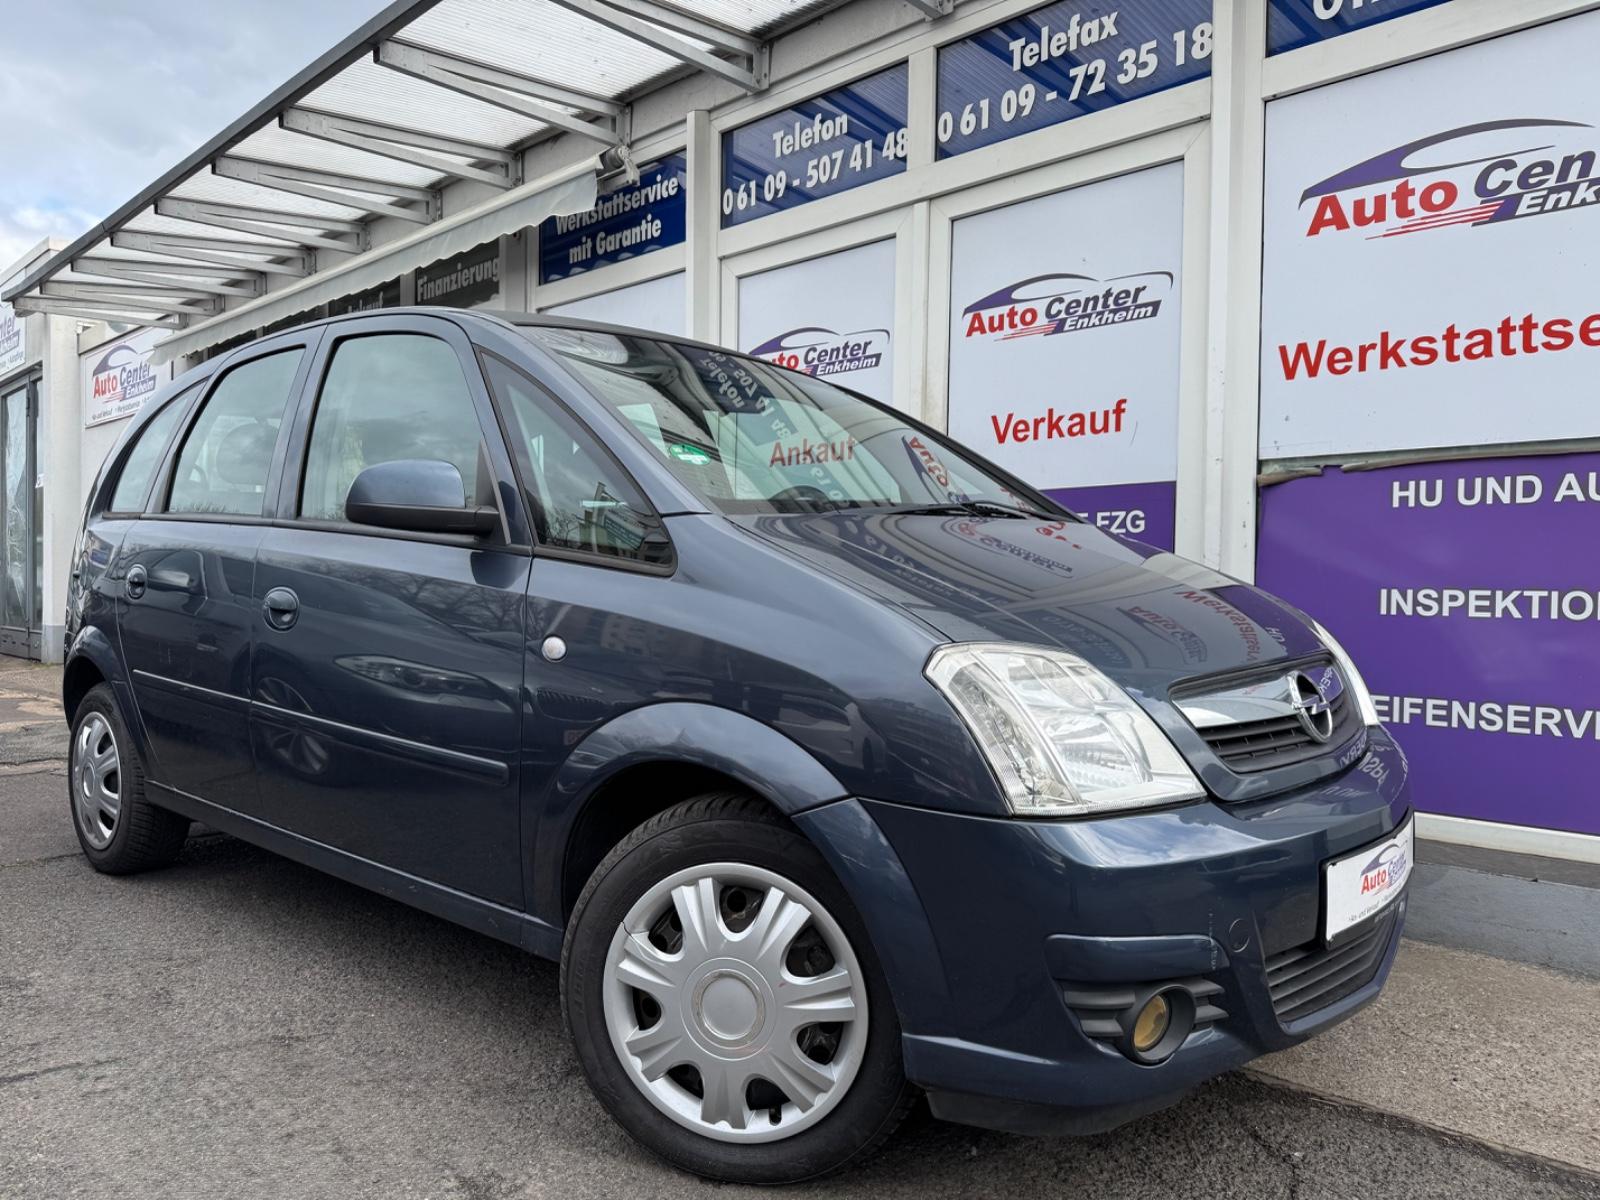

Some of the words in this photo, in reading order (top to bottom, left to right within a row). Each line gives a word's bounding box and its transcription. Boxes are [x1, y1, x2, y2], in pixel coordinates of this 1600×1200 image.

[1009, 11, 1118, 71] Telefax
[938, 112, 952, 143] 0
[960, 98, 989, 136] 61
[1000, 83, 1035, 122] 09
[1068, 59, 1106, 102] 72
[1117, 40, 1157, 85] 35
[1173, 22, 1213, 66] 18
[772, 113, 848, 158] Telefon
[723, 188, 733, 215] 0
[737, 180, 756, 210] 61
[764, 170, 787, 202] 09
[805, 149, 844, 188] 507
[849, 140, 873, 172] 41
[882, 127, 909, 160] 48
[1306, 178, 1458, 237] Auto
[569, 236, 593, 264] mit
[596, 214, 662, 255] Garantie
[417, 257, 500, 302] Finanzierung
[966, 305, 1038, 337] Auto
[1045, 285, 1147, 319] Center
[1063, 305, 1153, 332] Enkheim
[803, 340, 872, 365] Center
[816, 355, 876, 376] Enkheim
[1279, 312, 1600, 381] Werkstattse
[93, 373, 118, 399] Auto
[119, 360, 151, 386] Center
[991, 398, 1127, 444] Verkauf
[769, 435, 856, 467] Ankauf
[1392, 478, 1443, 508] HU
[1457, 474, 1543, 506] UND
[1380, 588, 1600, 621] INSPEKTIO
[1361, 869, 1387, 895] Auto
